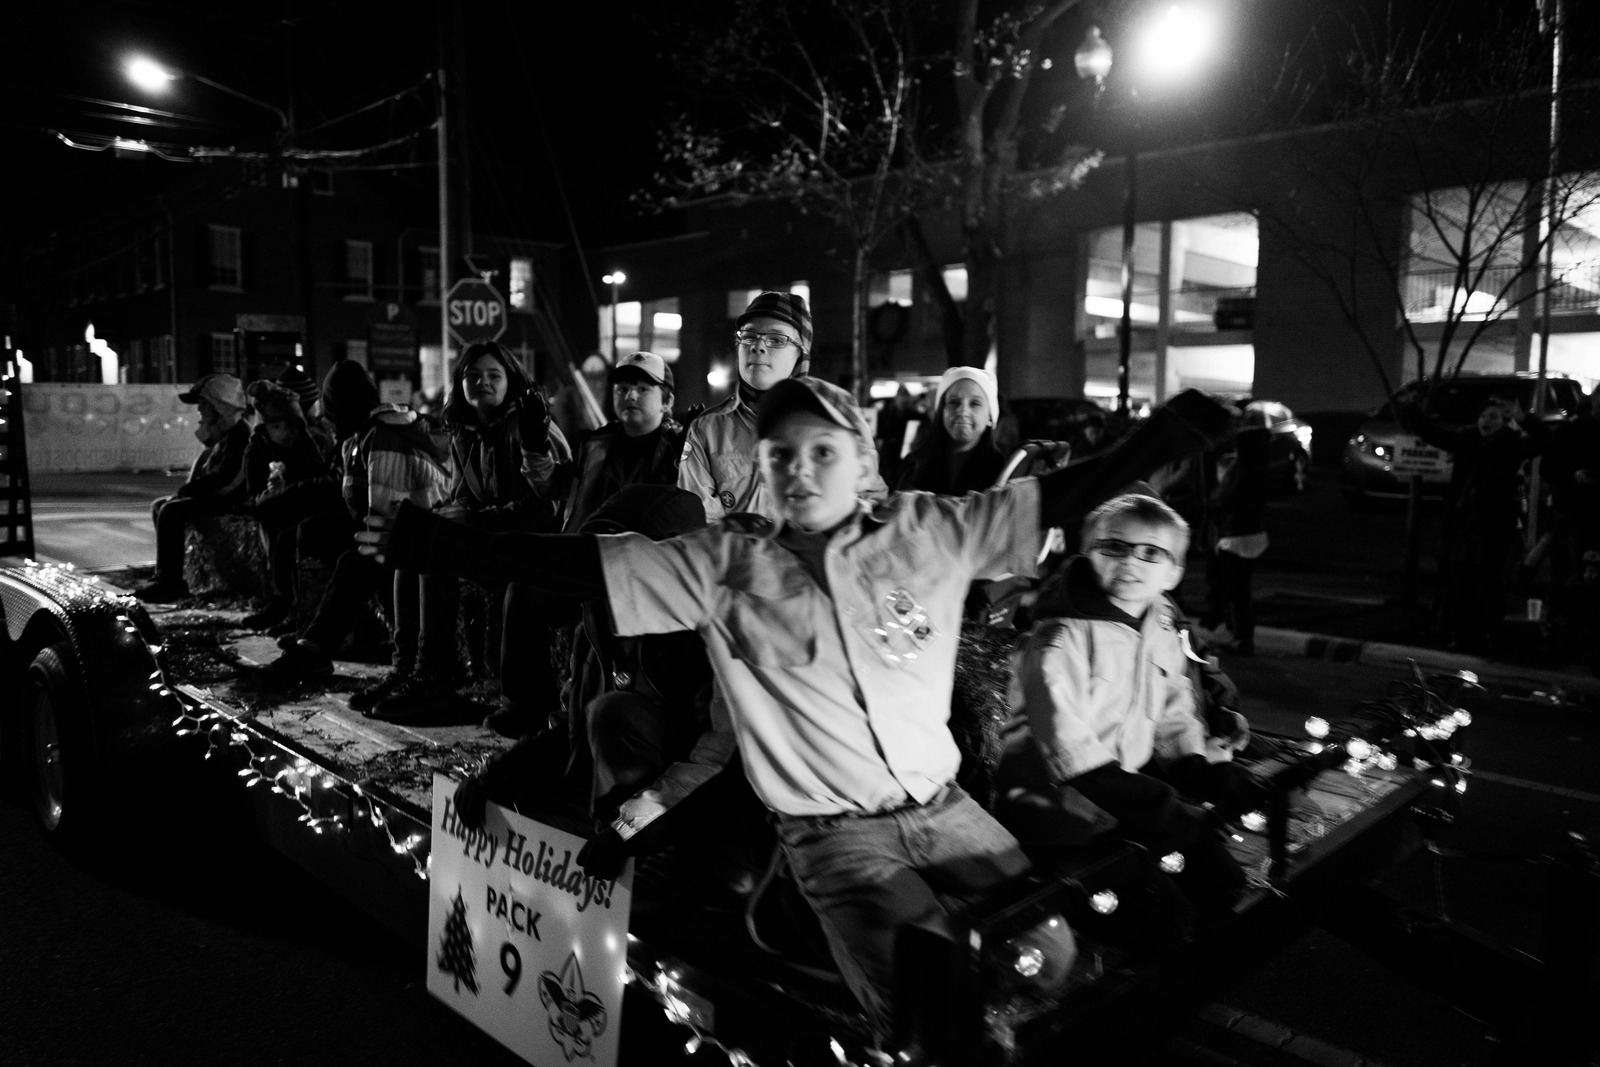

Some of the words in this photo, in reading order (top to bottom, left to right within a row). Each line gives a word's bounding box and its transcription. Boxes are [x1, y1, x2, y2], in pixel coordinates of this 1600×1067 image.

[449, 299, 501, 326] STOP
[441, 795, 499, 869] Happy
[502, 828, 615, 913] Holidays!
[486, 884, 542, 942] PACK
[500, 941, 522, 997] 9
